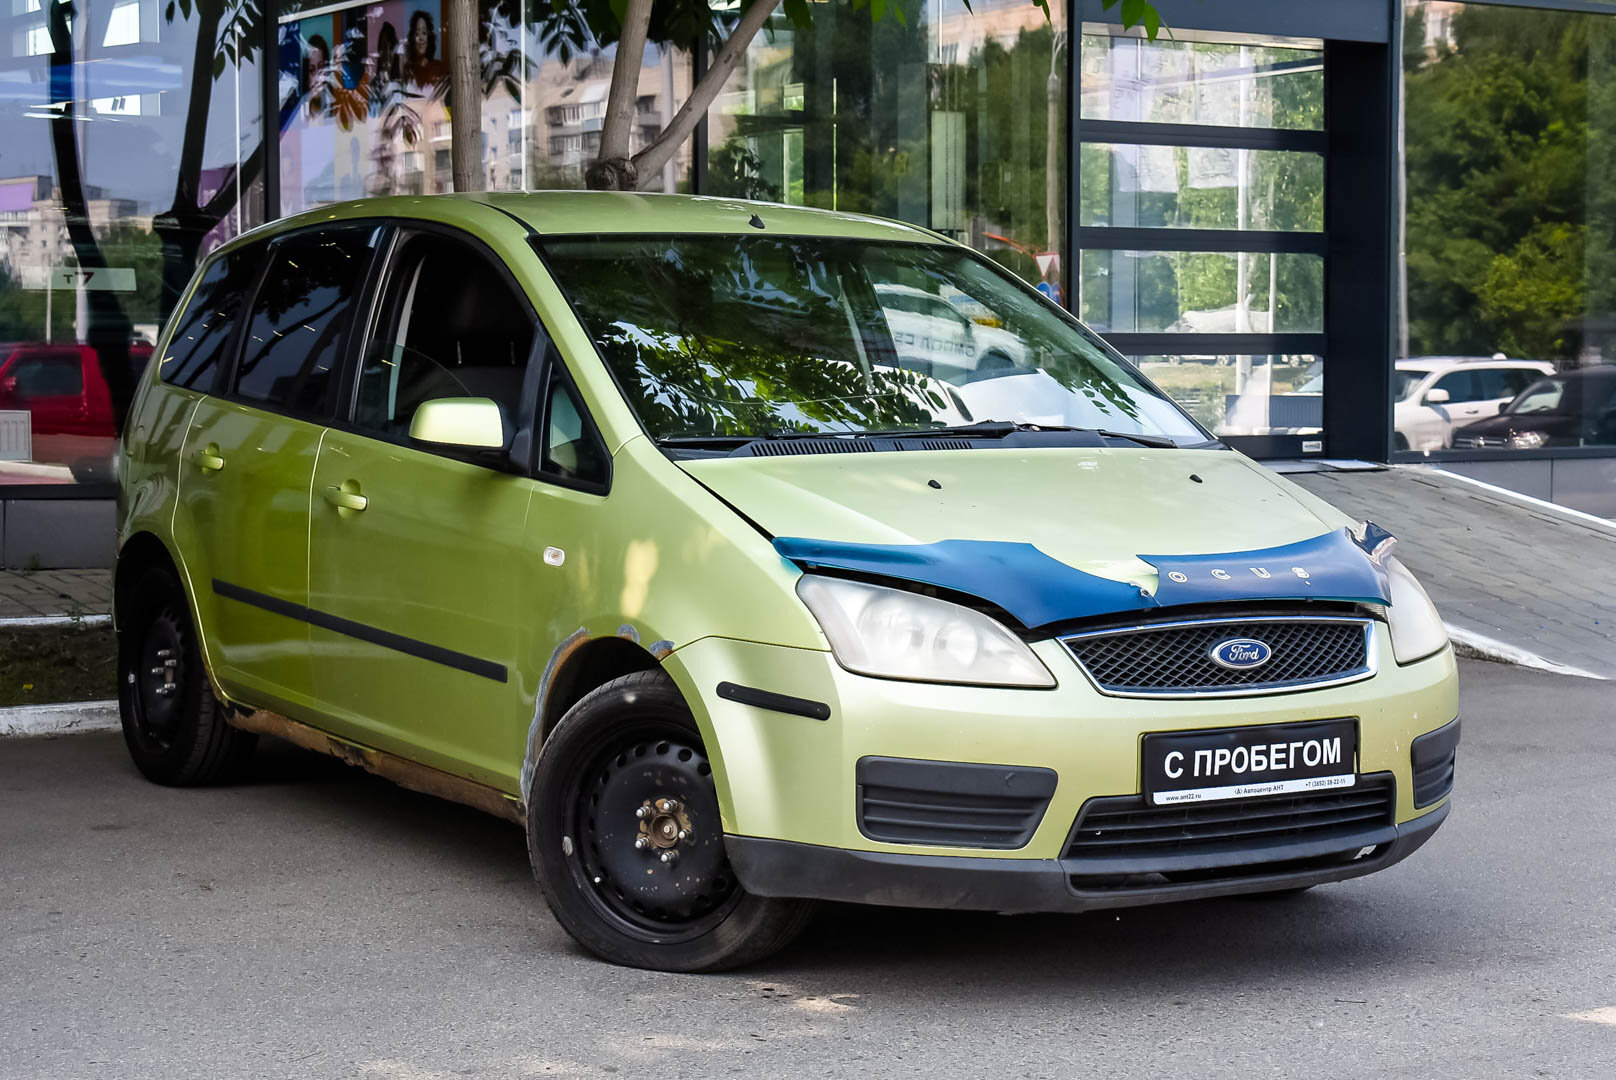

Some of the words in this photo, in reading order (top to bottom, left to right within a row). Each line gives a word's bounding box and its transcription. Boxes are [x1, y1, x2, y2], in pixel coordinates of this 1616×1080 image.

[1229, 644, 1259, 661] Ford
[1164, 751, 1184, 778] С
[1193, 737, 1341, 777] ПРОБЕГОМ
[1243, 786, 1272, 794] Автоцентр
[1166, 793, 1202, 801] www.ant22.ru
